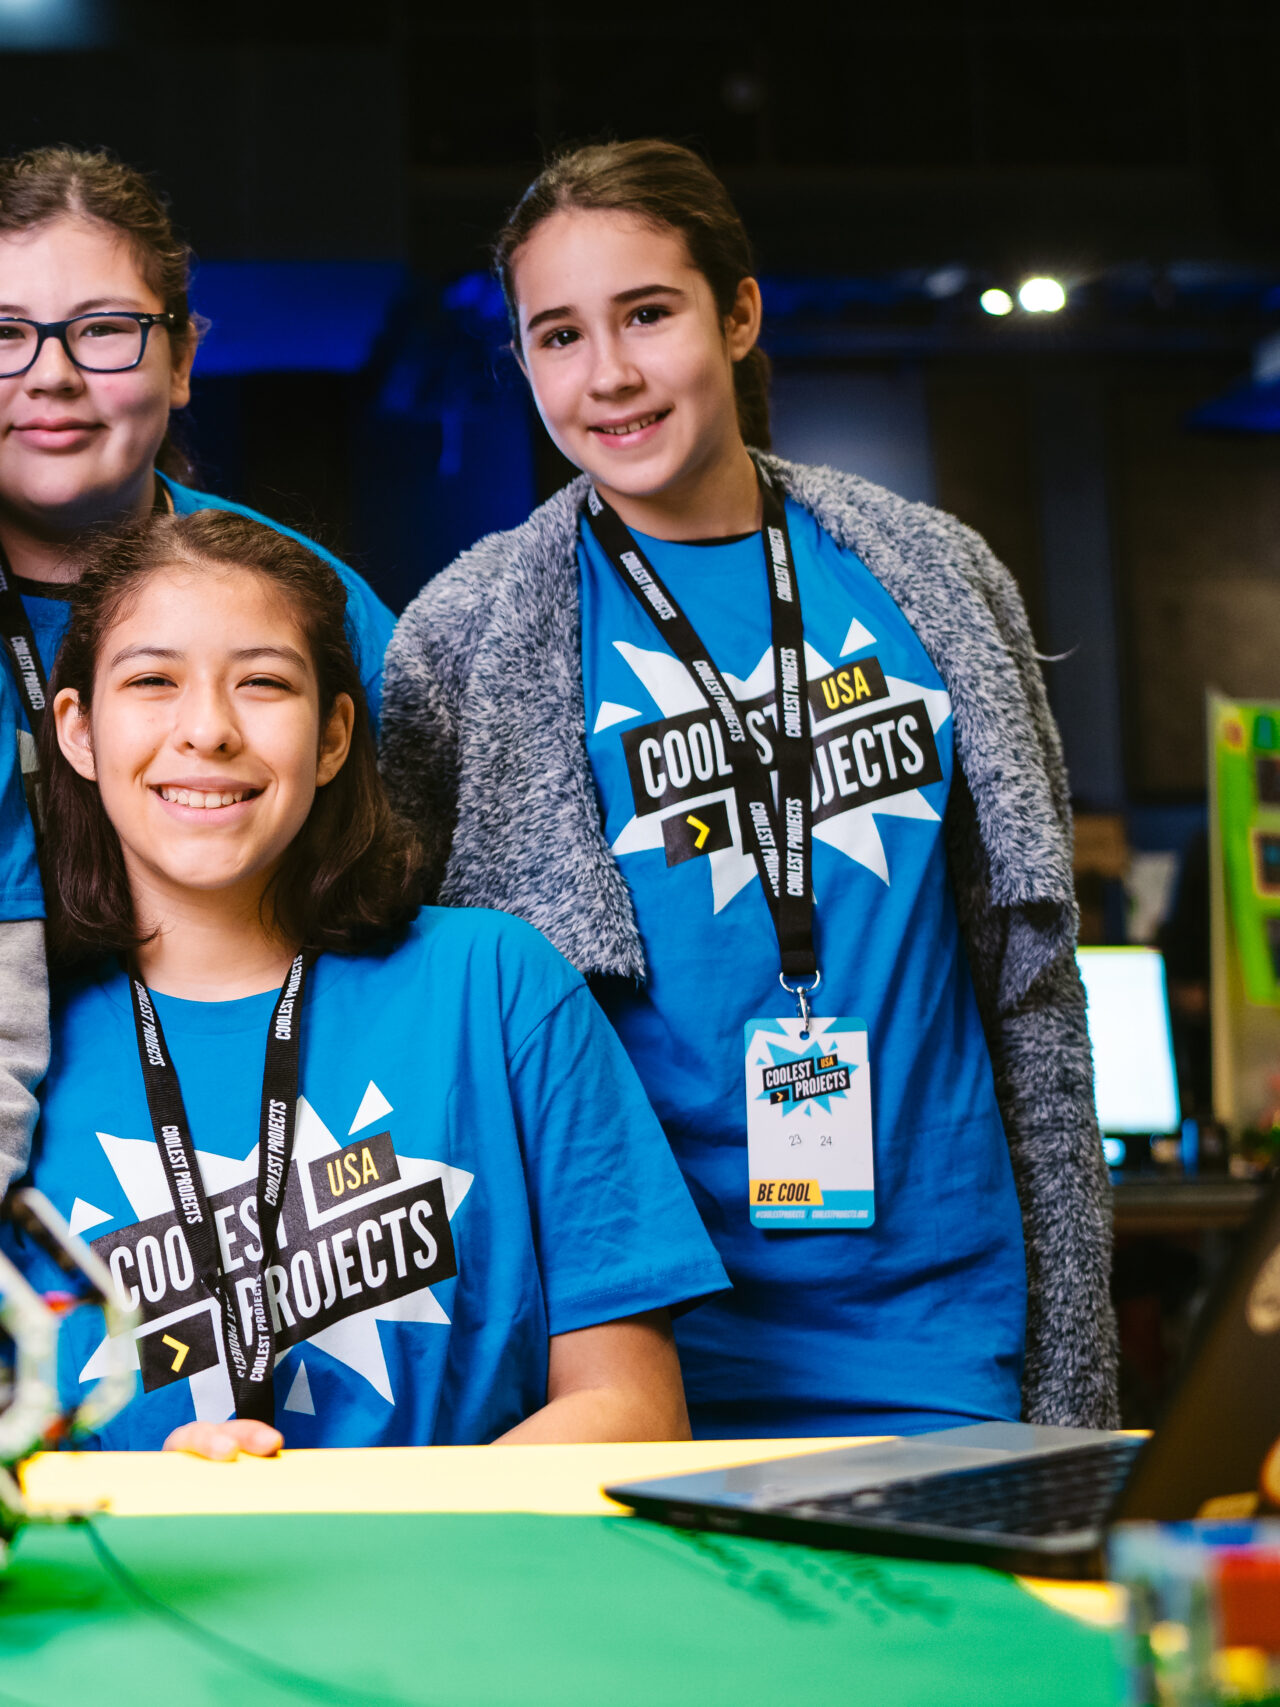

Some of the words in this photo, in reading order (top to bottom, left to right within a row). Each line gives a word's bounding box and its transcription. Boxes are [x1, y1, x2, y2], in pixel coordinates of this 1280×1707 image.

[780, 647, 800, 695] PROJECTS
[821, 666, 871, 710] USA
[783, 691, 802, 739] COOLEST
[749, 801, 776, 848] COOLEST
[786, 797, 803, 852] PROJECTS
[786, 850, 803, 897] COOLEST
[284, 954, 303, 999] PROJECTS
[134, 980, 154, 1024] COOLEST
[275, 998, 295, 1040] COOLEST
[143, 1022, 166, 1067] PROJECTS
[820, 1056, 834, 1068] USA
[765, 1060, 811, 1087] COOLEST
[795, 1071, 847, 1098] PROJECTS
[162, 1125, 189, 1172] COOLEST
[267, 1099, 287, 1156] PROJECTS
[789, 1134, 802, 1146] 23
[820, 1135, 833, 1146] 24
[264, 1152, 285, 1207] COOLEST
[326, 1146, 380, 1196] USA
[757, 1183, 775, 1202] BE
[777, 1183, 811, 1202] COOL
[175, 1165, 203, 1225] PROJECTS
[250, 1334, 271, 1382] COOLEST
